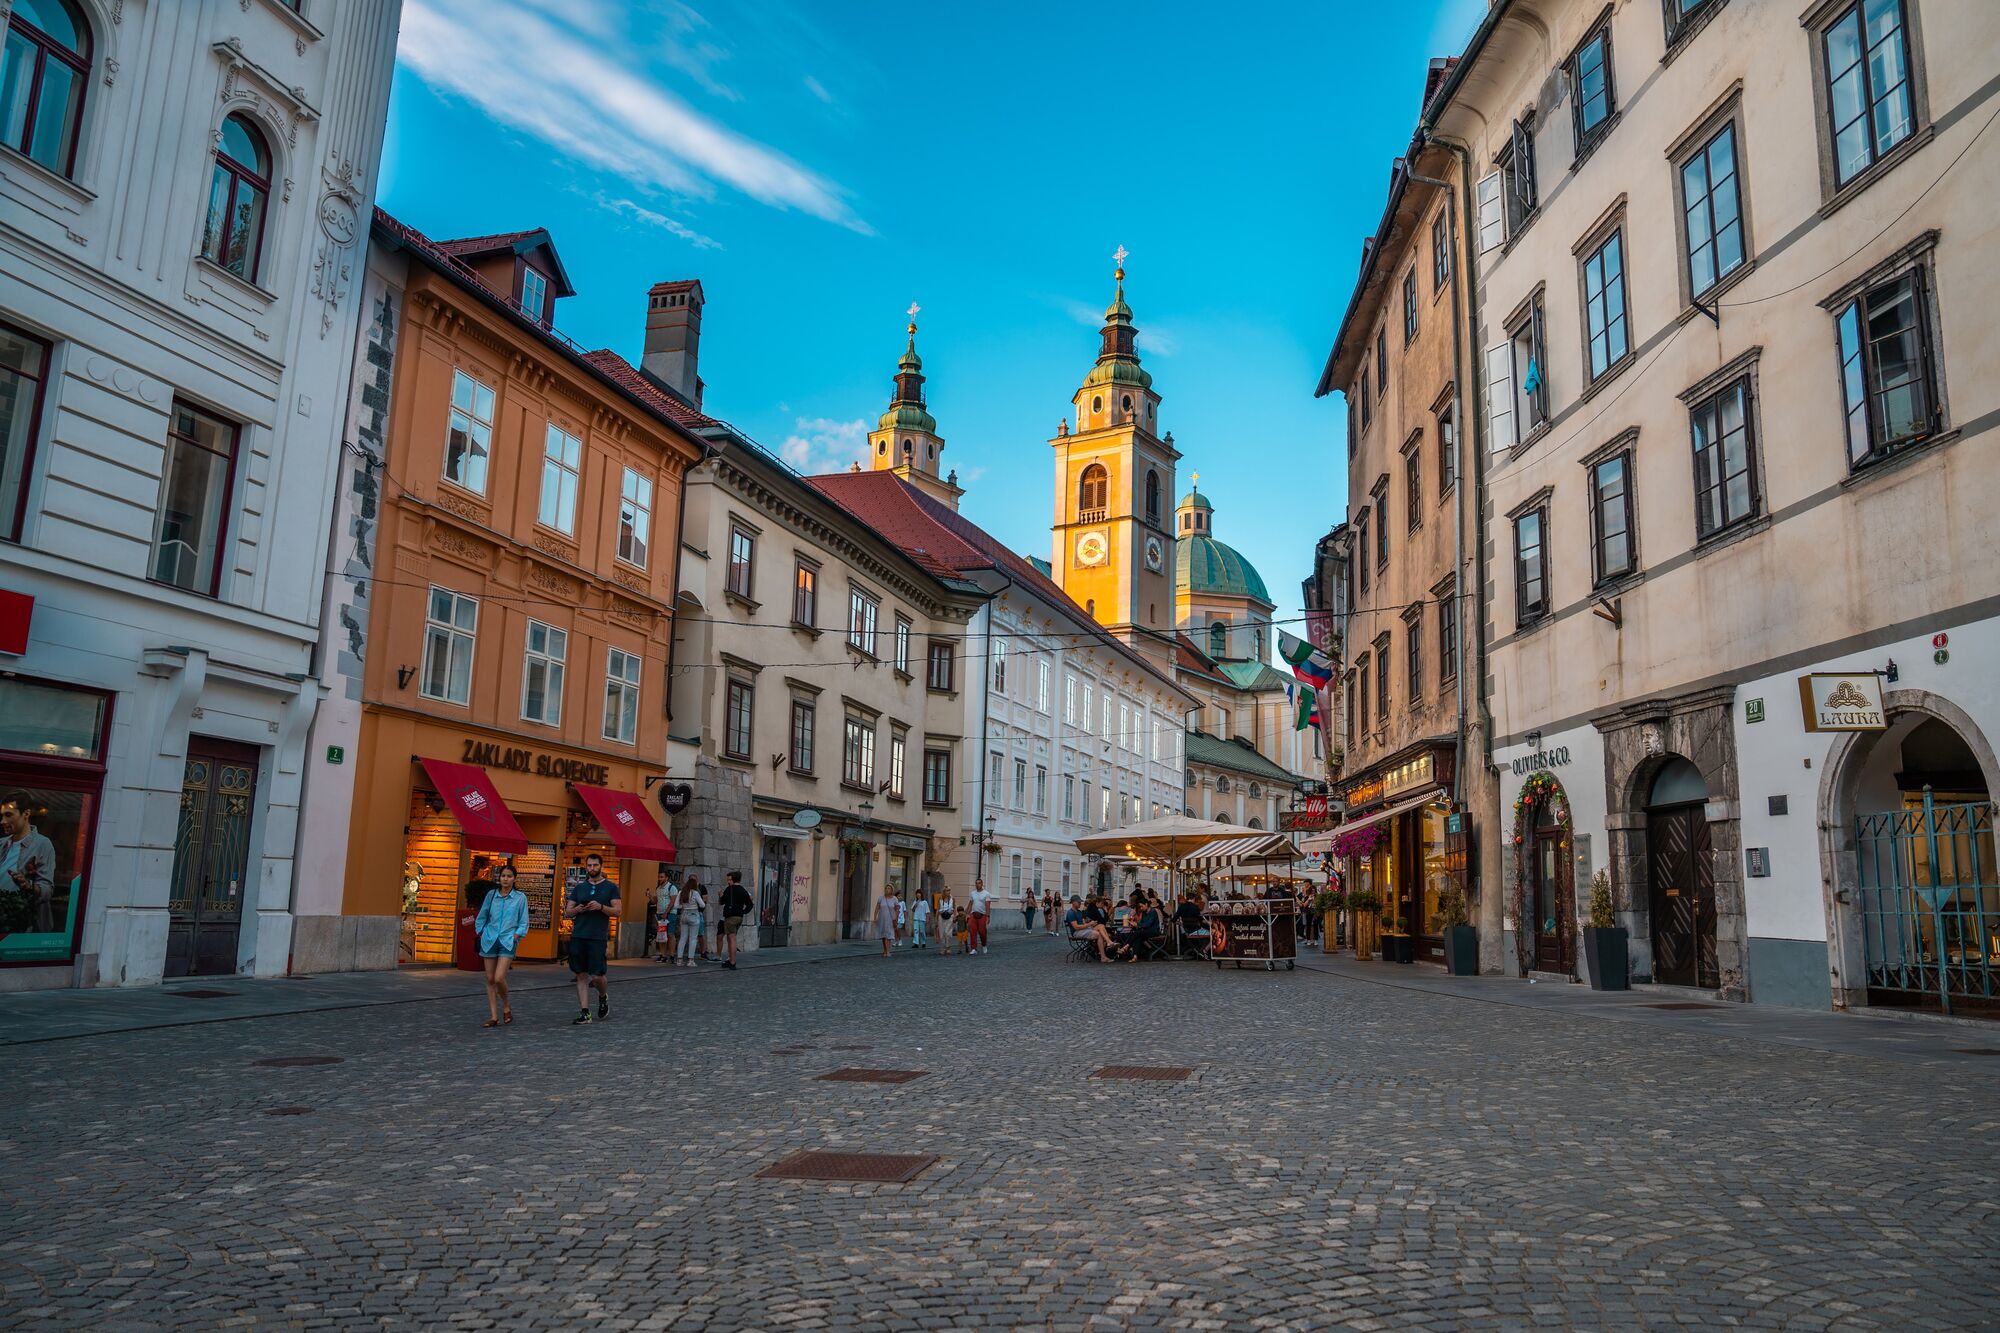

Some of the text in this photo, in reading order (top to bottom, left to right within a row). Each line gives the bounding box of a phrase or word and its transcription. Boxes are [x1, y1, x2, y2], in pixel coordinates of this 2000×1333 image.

[1749, 702, 1758, 714] 20
[1820, 711, 1881, 725] LAURA
[462, 739, 610, 786] ZAKLADI SLOVENIJE
[1512, 750, 1548, 775] OLIVIERS
[1307, 799, 1327, 816] illy
